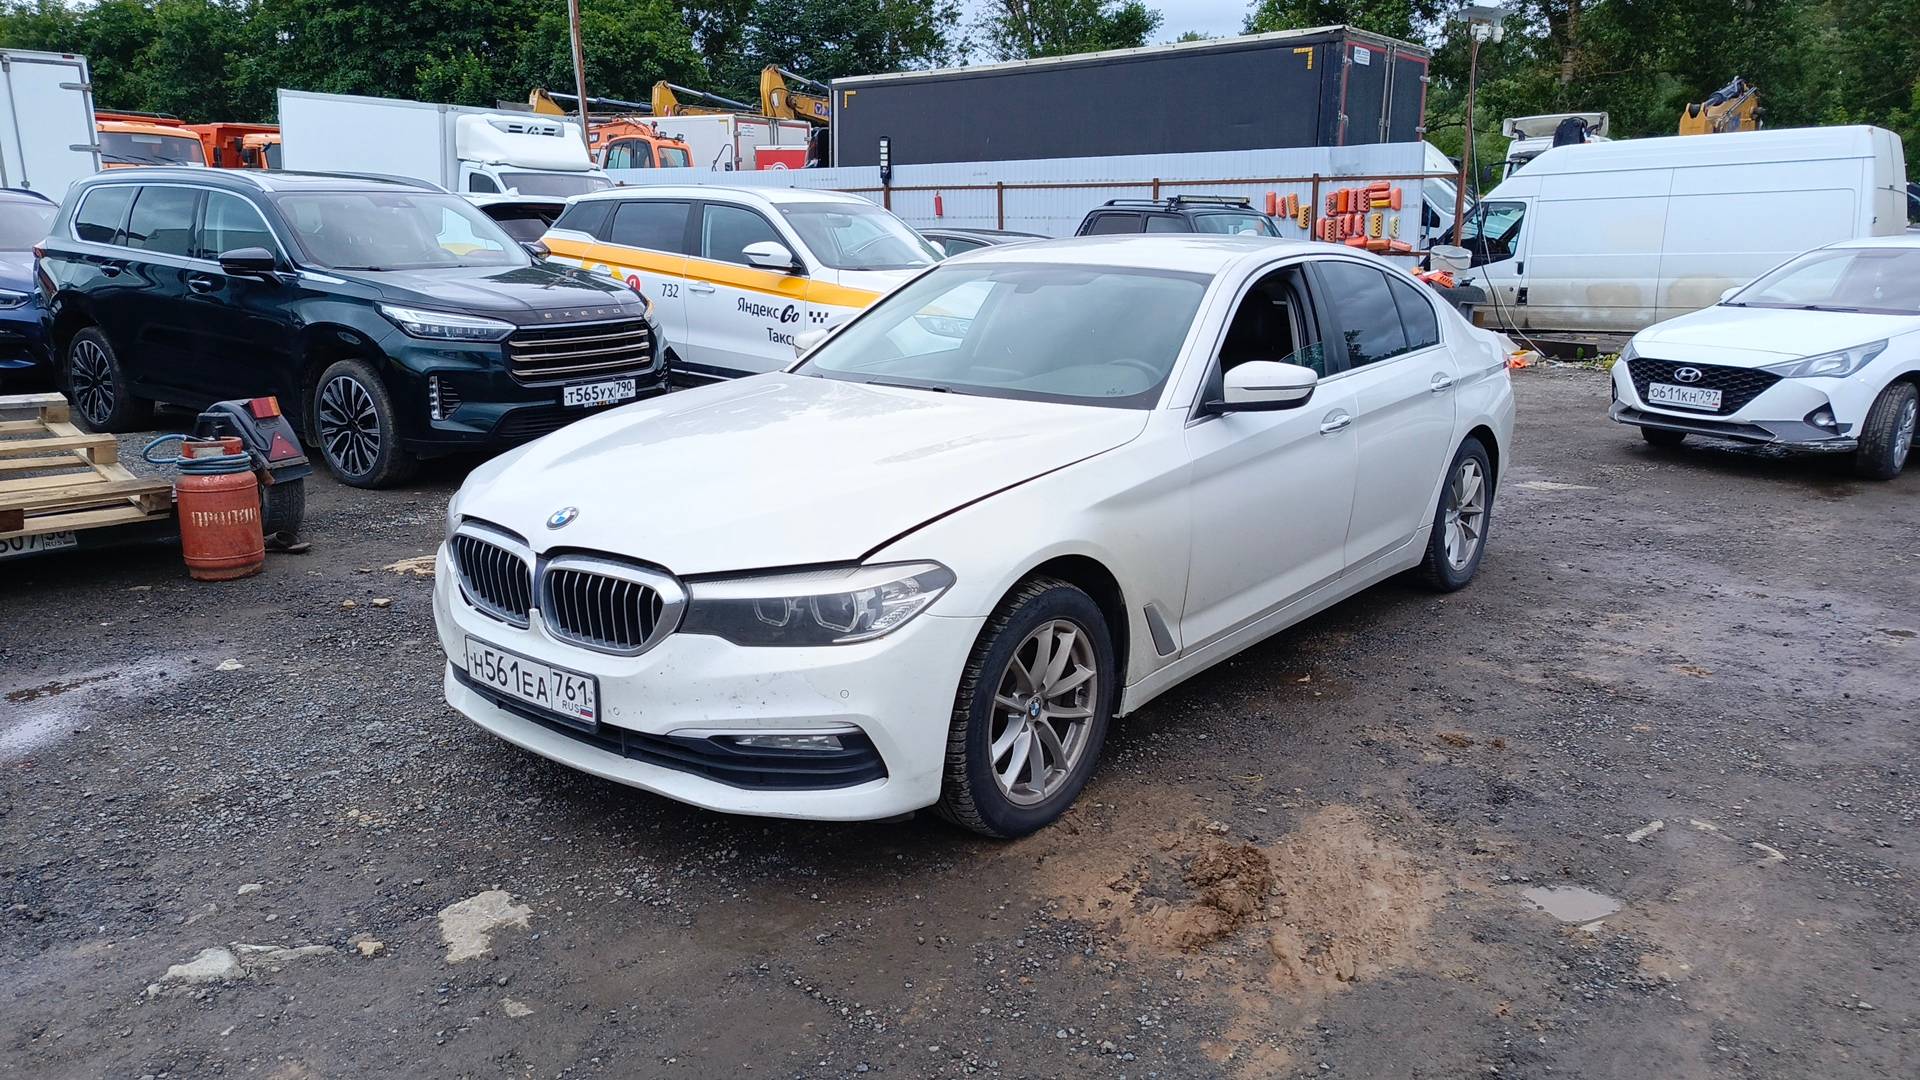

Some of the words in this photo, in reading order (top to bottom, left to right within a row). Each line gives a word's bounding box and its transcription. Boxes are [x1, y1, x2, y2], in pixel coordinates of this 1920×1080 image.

[662, 283, 679, 298] 732
[737, 297, 780, 320] Яндекс
[780, 304, 800, 323] Go
[562, 700, 580, 713] RUS
